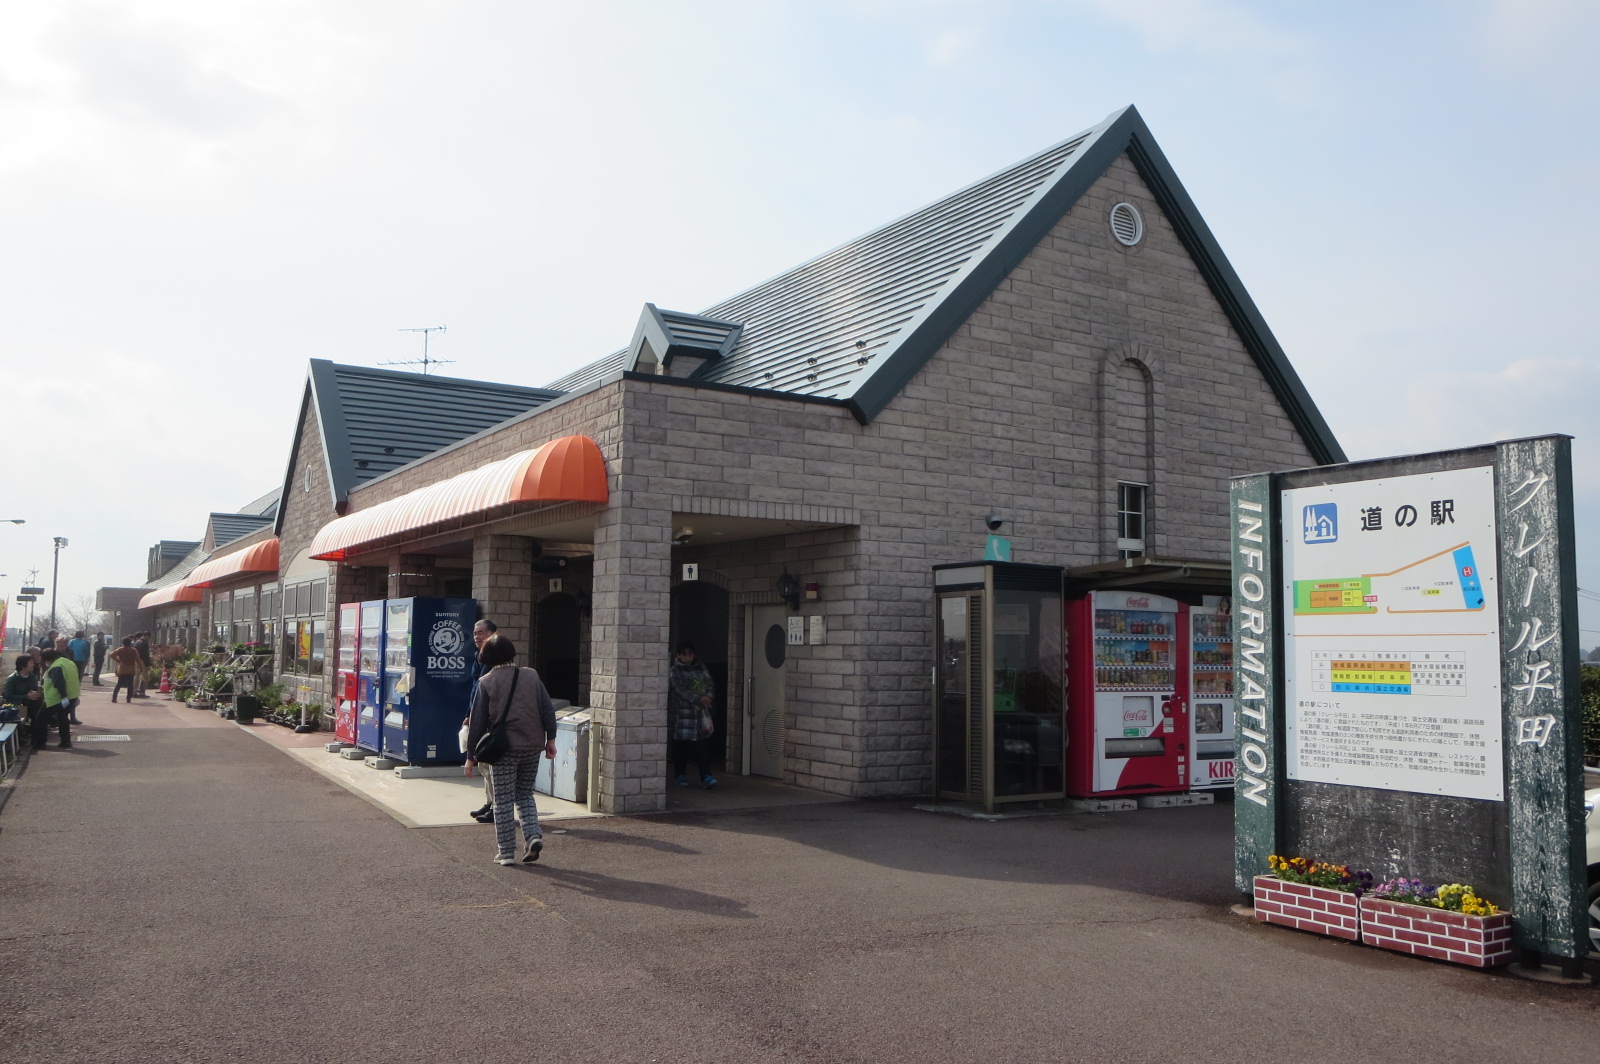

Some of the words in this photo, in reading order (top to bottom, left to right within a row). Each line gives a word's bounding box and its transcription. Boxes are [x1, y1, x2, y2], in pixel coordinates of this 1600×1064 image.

[1361, 499, 1455, 532] 道の駅
[1508, 469, 1559, 748] クレール平田
[432, 620, 462, 631] COFFEE
[427, 656, 466, 669] BOSS
[1238, 498, 1268, 806] INFORMATION
[1124, 710, 1148, 721] Coca-Cola
